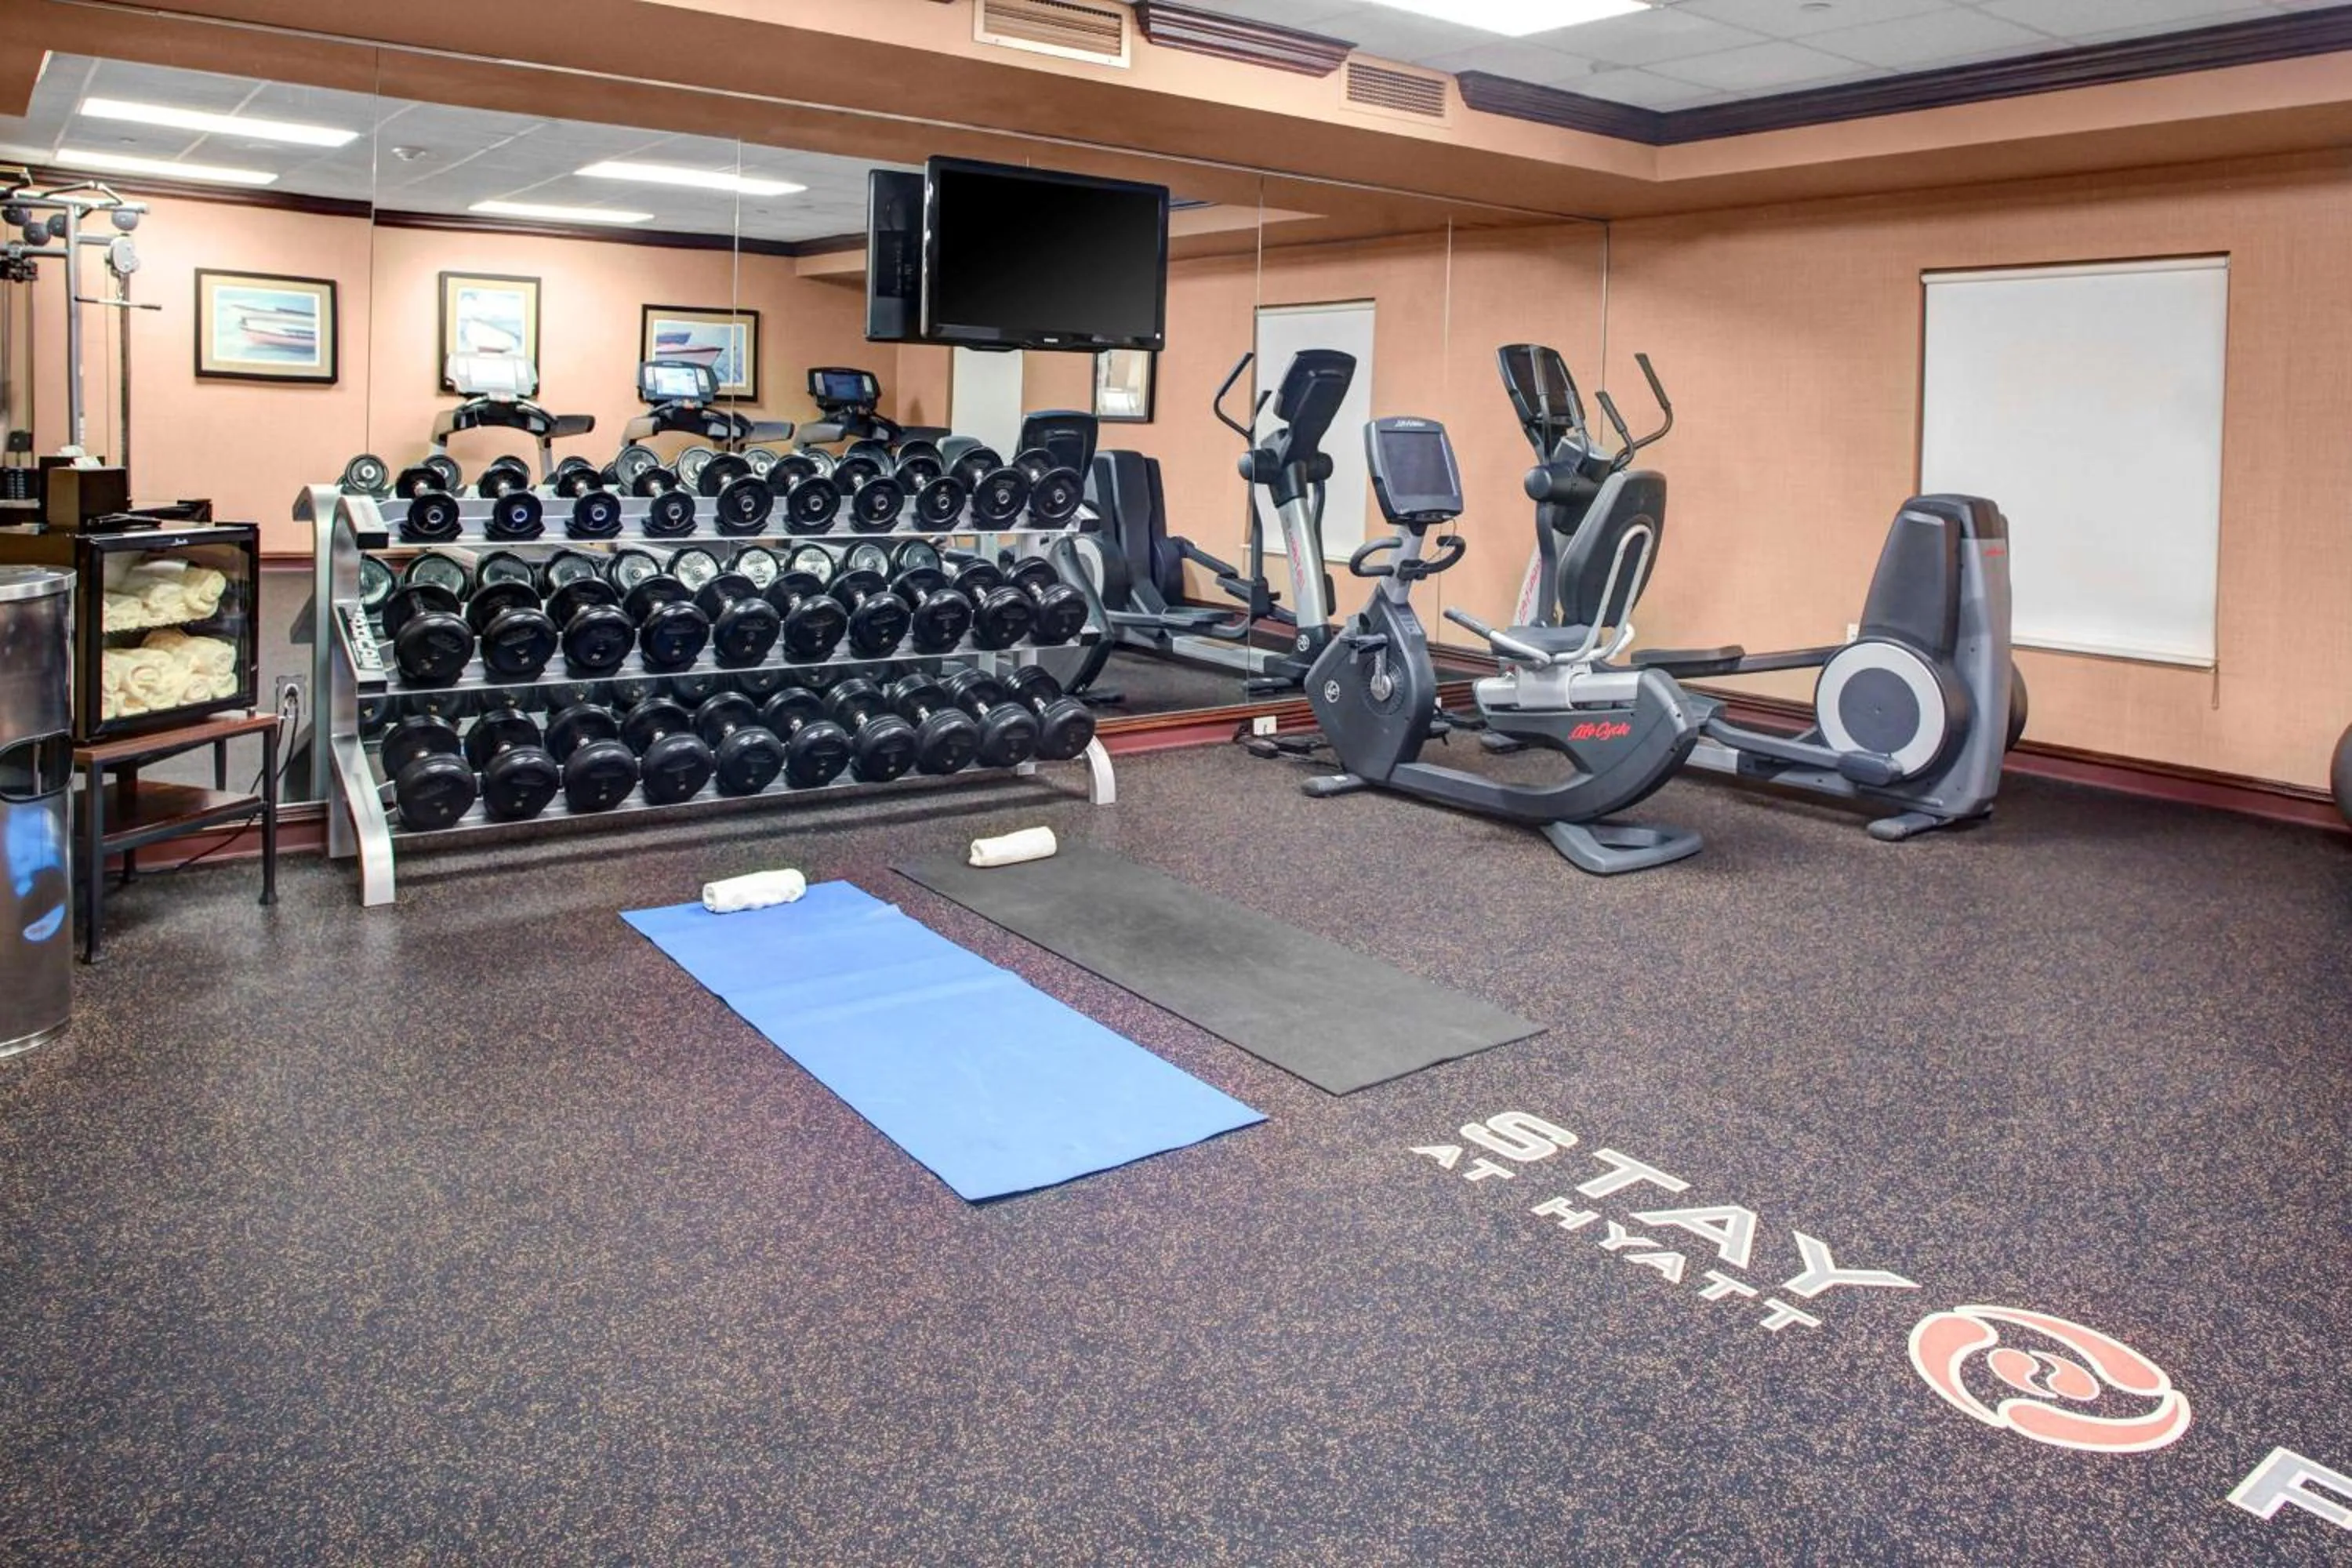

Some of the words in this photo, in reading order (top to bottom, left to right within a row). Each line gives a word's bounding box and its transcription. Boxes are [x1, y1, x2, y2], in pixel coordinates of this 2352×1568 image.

[1410, 1144, 1516, 1181] AT
[1530, 1196, 1822, 1332] HYATT
[1459, 1111, 1922, 1298] STAY
